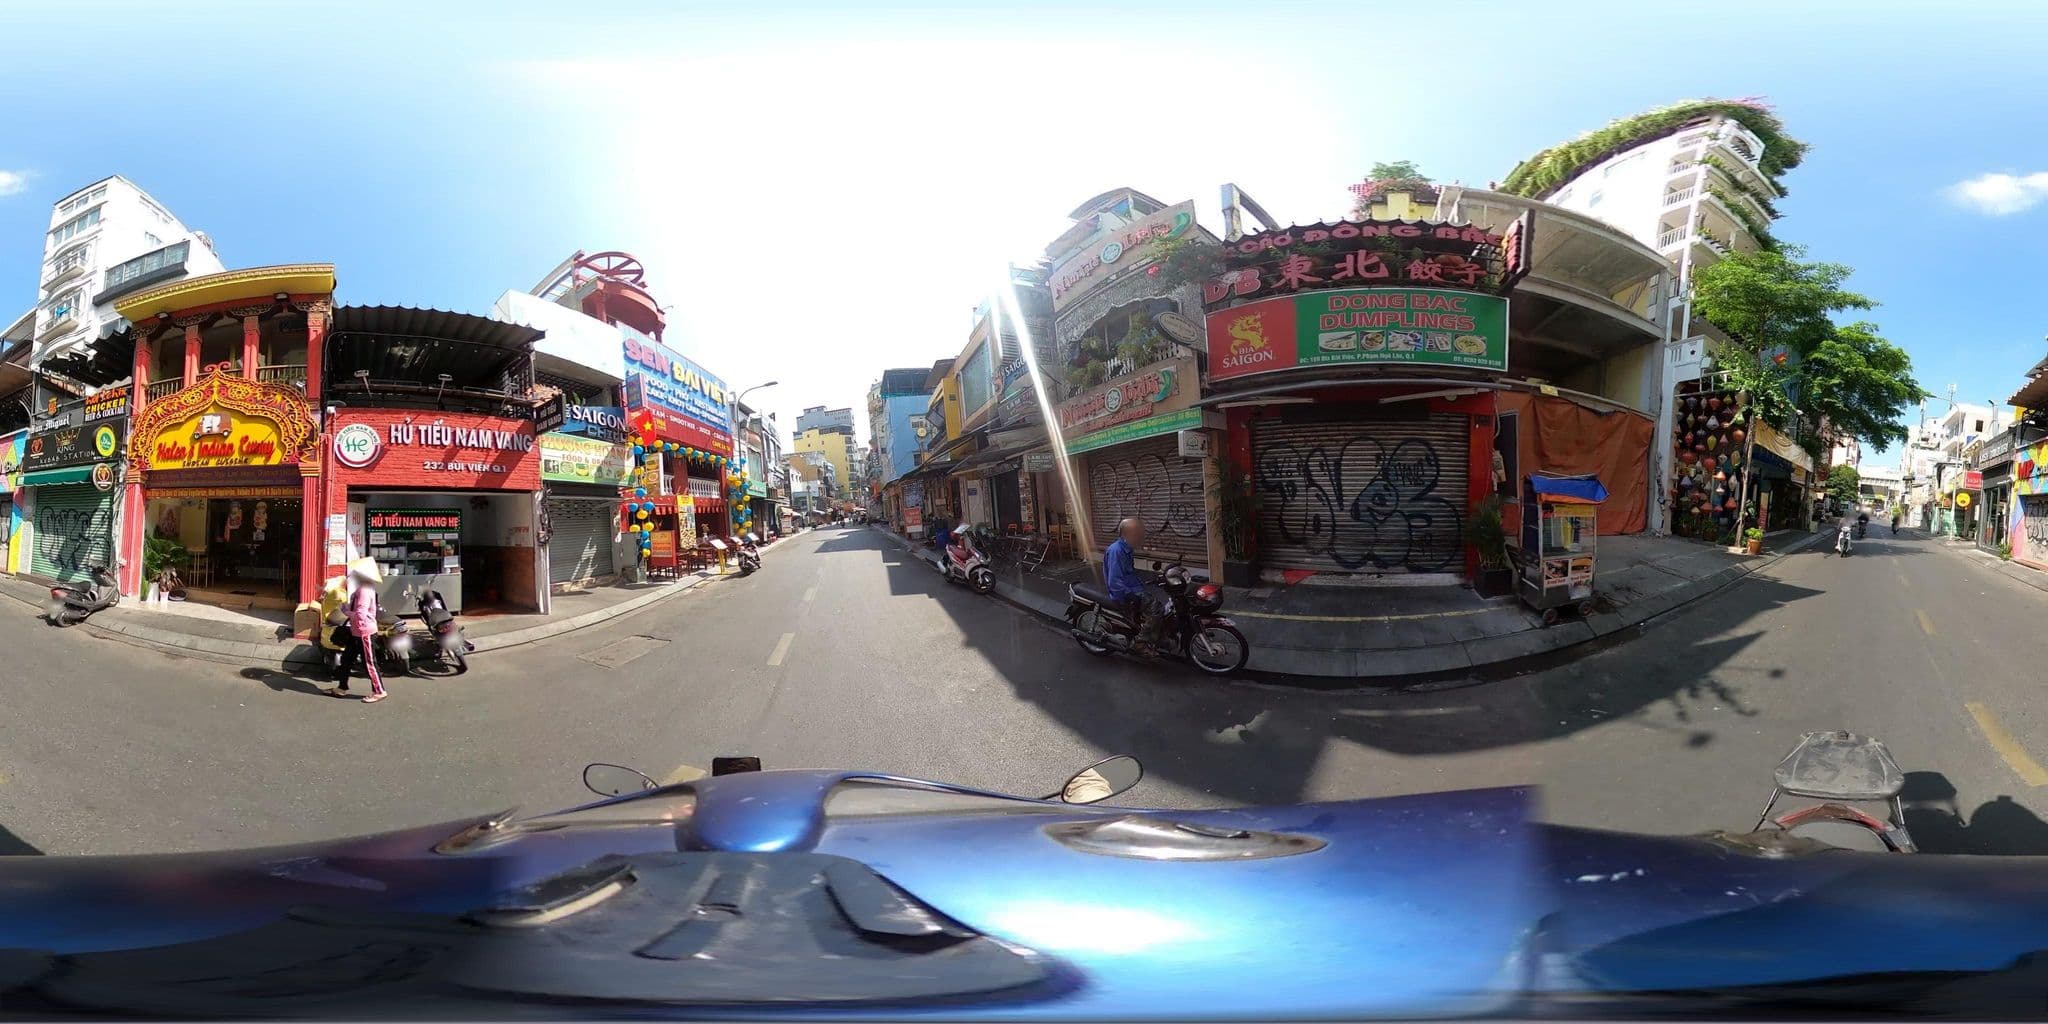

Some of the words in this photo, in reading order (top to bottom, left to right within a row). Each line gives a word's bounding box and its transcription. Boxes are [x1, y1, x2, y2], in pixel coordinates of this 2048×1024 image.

[1328, 294, 1407, 311] DONG
[1410, 294, 1468, 312] BAC
[1319, 312, 1476, 331] DUMPLINGS
[624, 338, 670, 375] SEN
[1222, 351, 1274, 368] SAIGON
[1239, 347, 1255, 356] BIA
[85, 397, 126, 414] CHICKEN
[45, 414, 71, 431] Miguel
[572, 404, 628, 432] SAIGON
[390, 417, 412, 445] HỦ
[418, 419, 452, 448] TIẾU
[455, 429, 491, 451] NAM
[491, 431, 534, 454] VANG
[56, 444, 76, 454] KING
[63, 450, 96, 462] STATION
[423, 460, 445, 470] 232
[447, 460, 466, 471] BÙI
[467, 461, 490, 473] VIỆN
[491, 464, 507, 474] Q.1
[371, 513, 383, 527] HỦ
[385, 512, 402, 528] TIẾU
[403, 517, 424, 527] NAM
[425, 517, 447, 527] VANG
